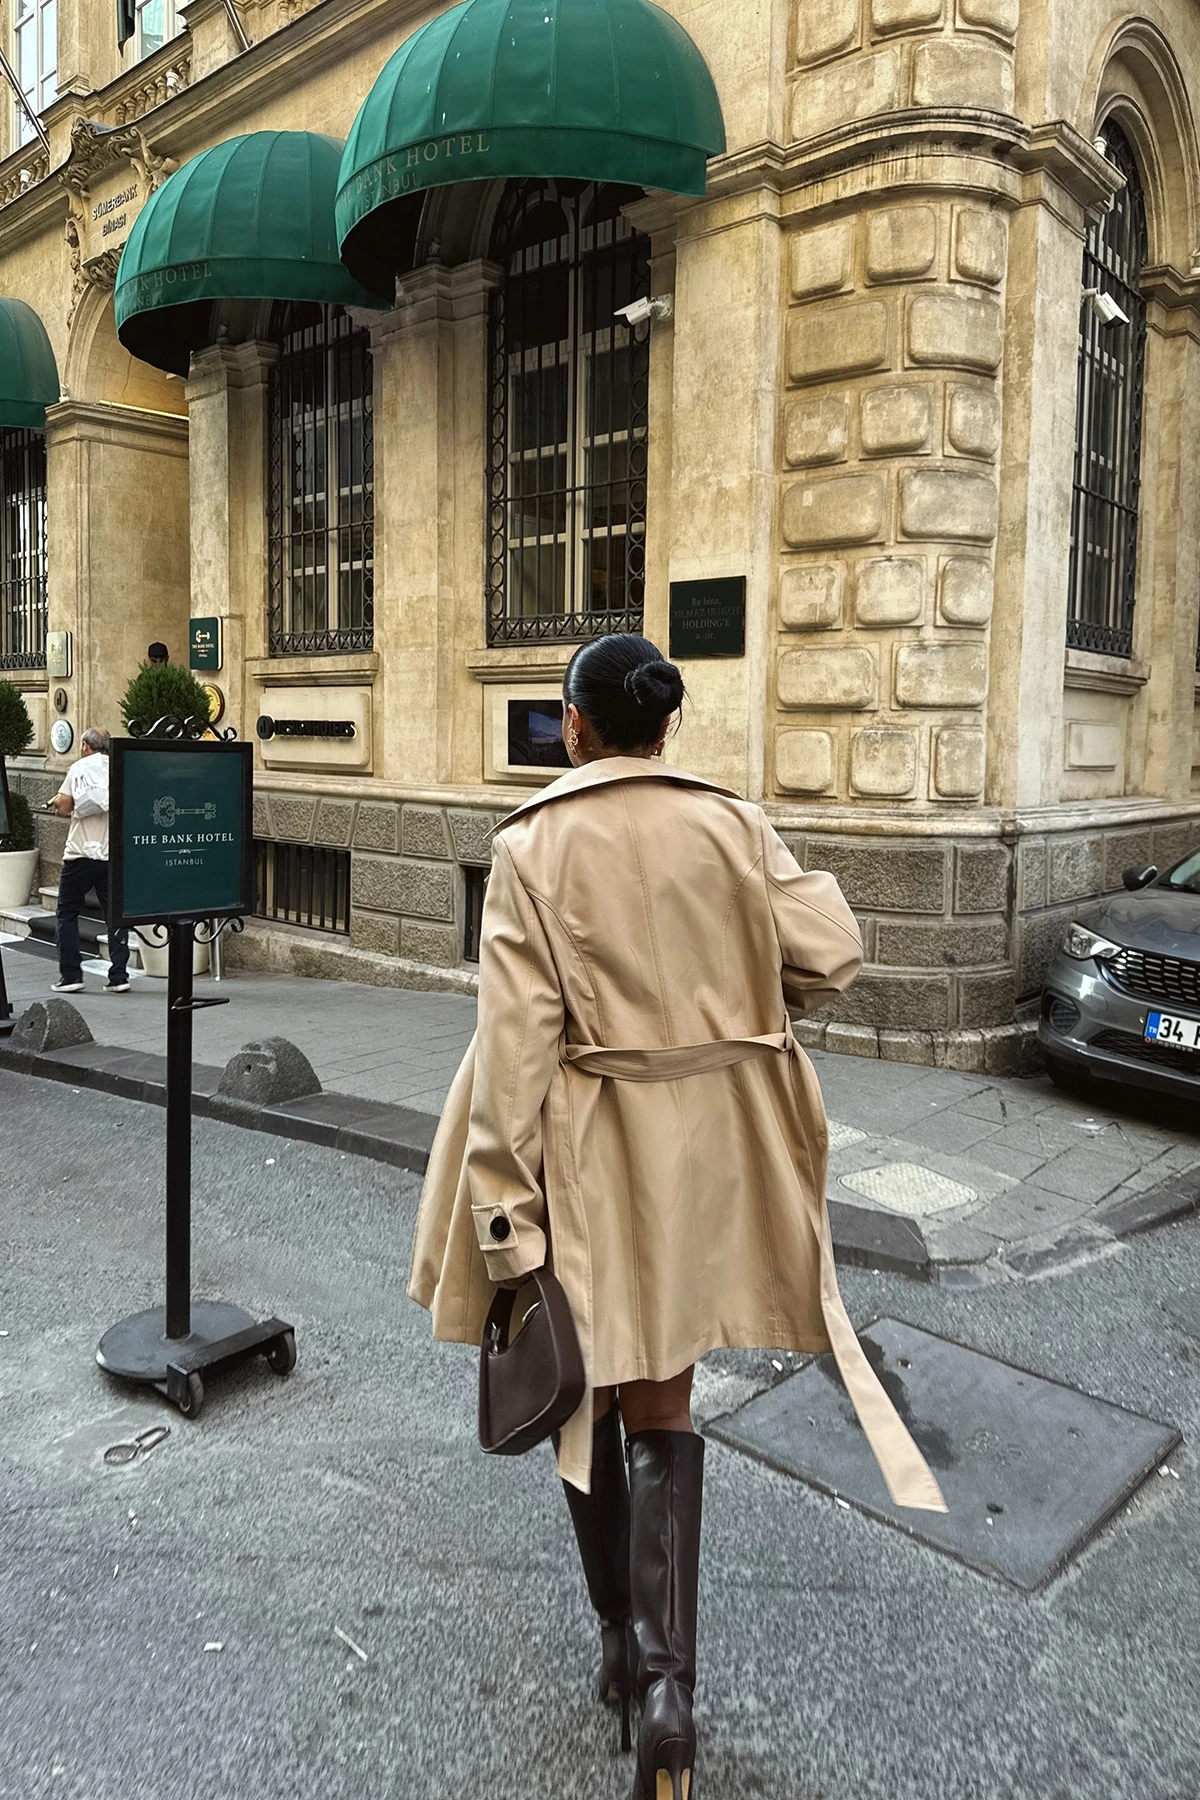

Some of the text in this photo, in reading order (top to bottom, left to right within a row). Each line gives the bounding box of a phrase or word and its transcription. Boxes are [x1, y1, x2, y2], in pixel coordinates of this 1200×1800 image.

[355, 155, 397, 195] BANK
[406, 133, 490, 168] HOTEL
[153, 262, 212, 287] HOTEL
[691, 597, 701, 606] Bu
[132, 832, 234, 845] THE BANK HOTEL
[165, 858, 204, 867] ISTANBUL
[1148, 1025, 1158, 1035] TR
[1159, 1017, 1184, 1042] 34
